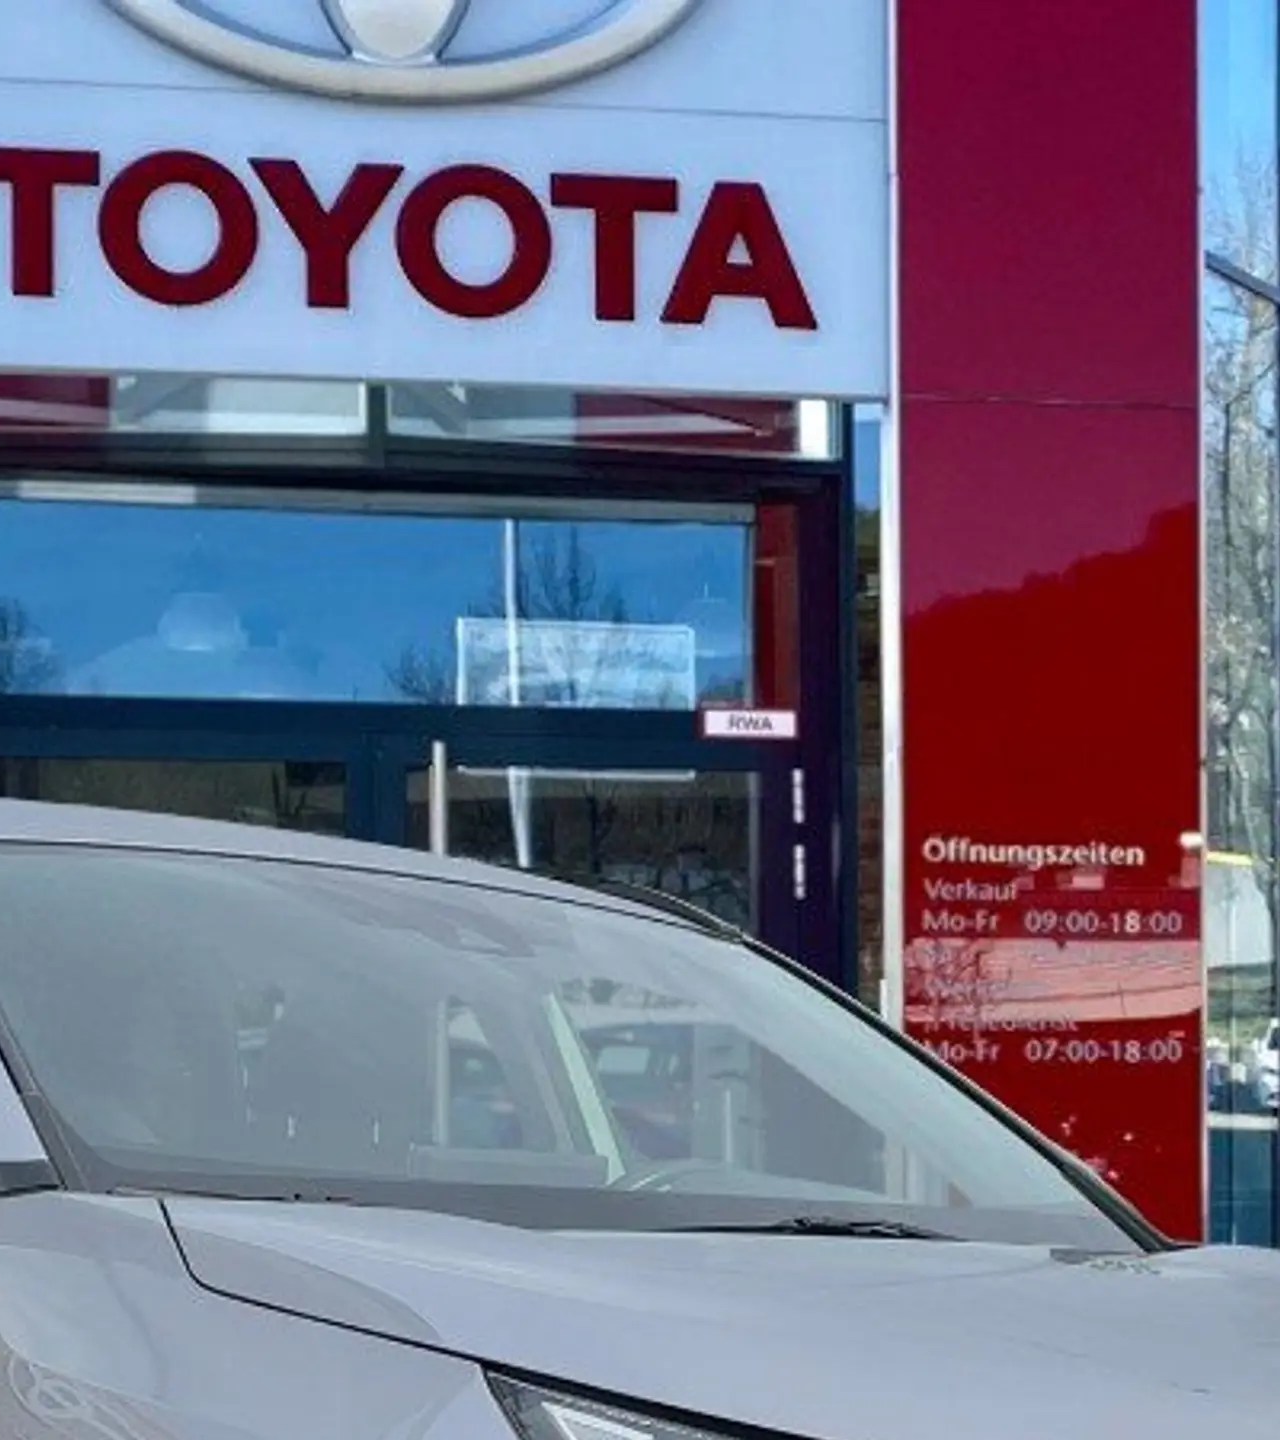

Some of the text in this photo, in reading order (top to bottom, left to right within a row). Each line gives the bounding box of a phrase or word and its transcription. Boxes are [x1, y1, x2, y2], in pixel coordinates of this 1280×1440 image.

[922, 836, 1146, 868] Öffnungszeiten
[923, 877, 1019, 901] Verkauf
[922, 909, 1183, 933] Mo-Fr 09:00-18:00
[1024, 1039, 1183, 1063] 07:00-18:00
